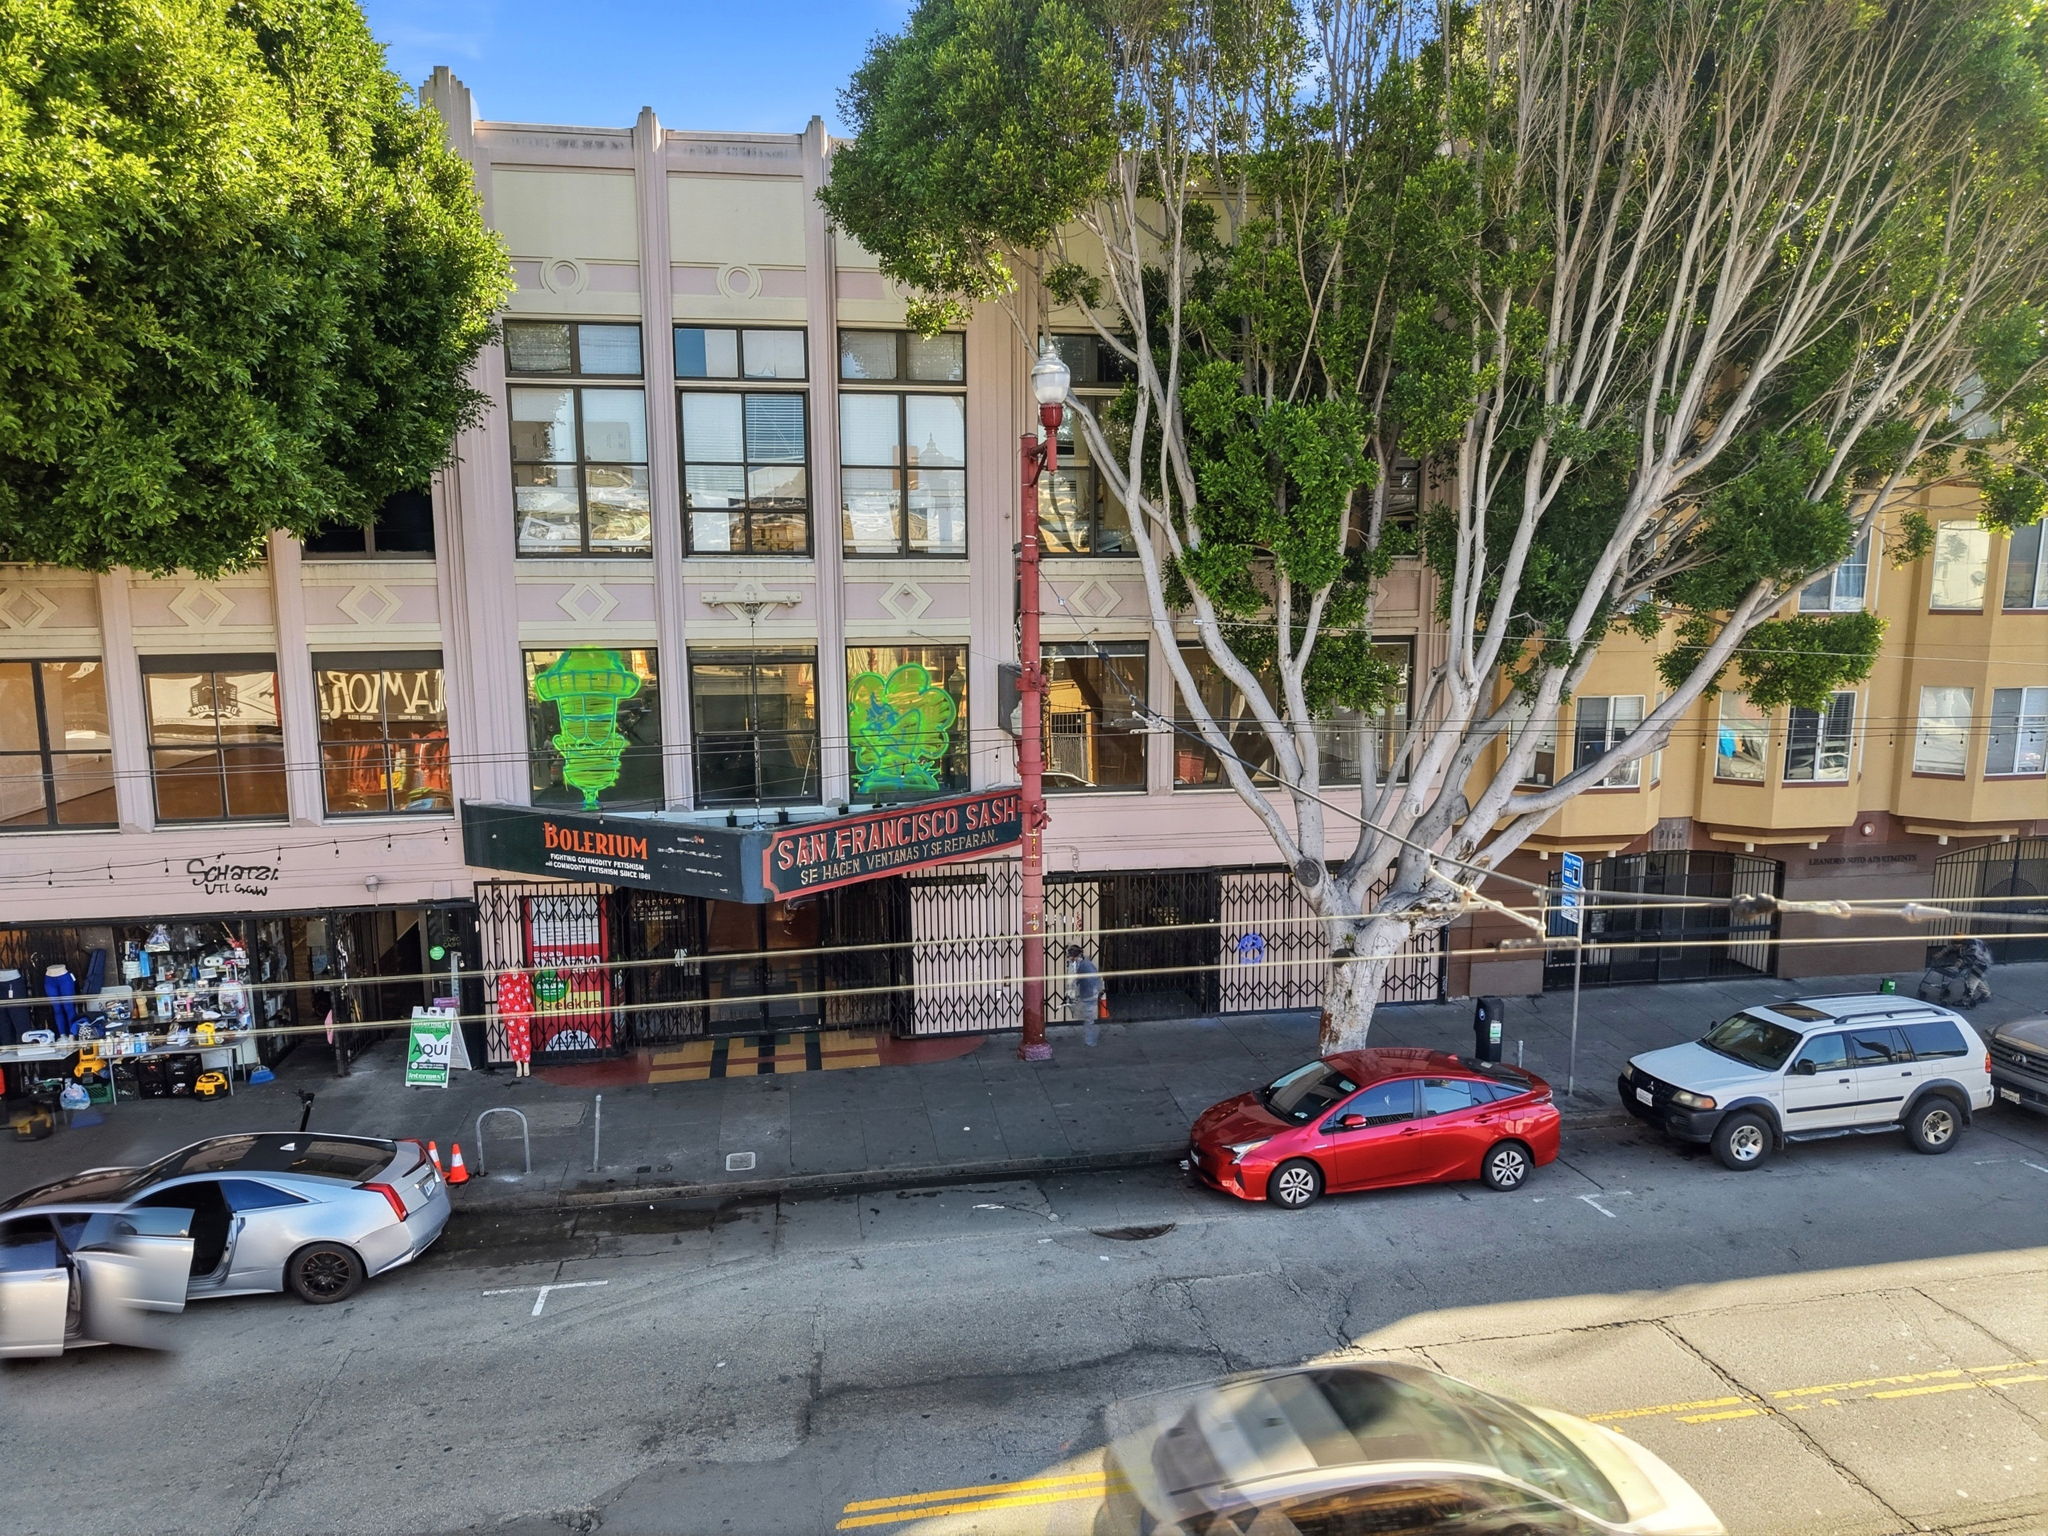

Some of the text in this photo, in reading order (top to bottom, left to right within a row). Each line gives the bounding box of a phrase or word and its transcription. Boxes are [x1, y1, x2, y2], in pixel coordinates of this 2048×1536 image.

[543, 821, 648, 860] BOLERIUM
[777, 797, 1017, 871] SAN FRANCISCO SASH
[550, 853, 645, 871] FIGHTING COMMODITY FETISHISM
[553, 861, 587, 872] COMMODITY
[588, 865, 619, 876] FETISHISM
[619, 869, 638, 879] SINCE
[800, 829, 999, 885] SE HACEN VENTANAS Y SE REPARAN.
[411, 1040, 450, 1058] AQUÍ
